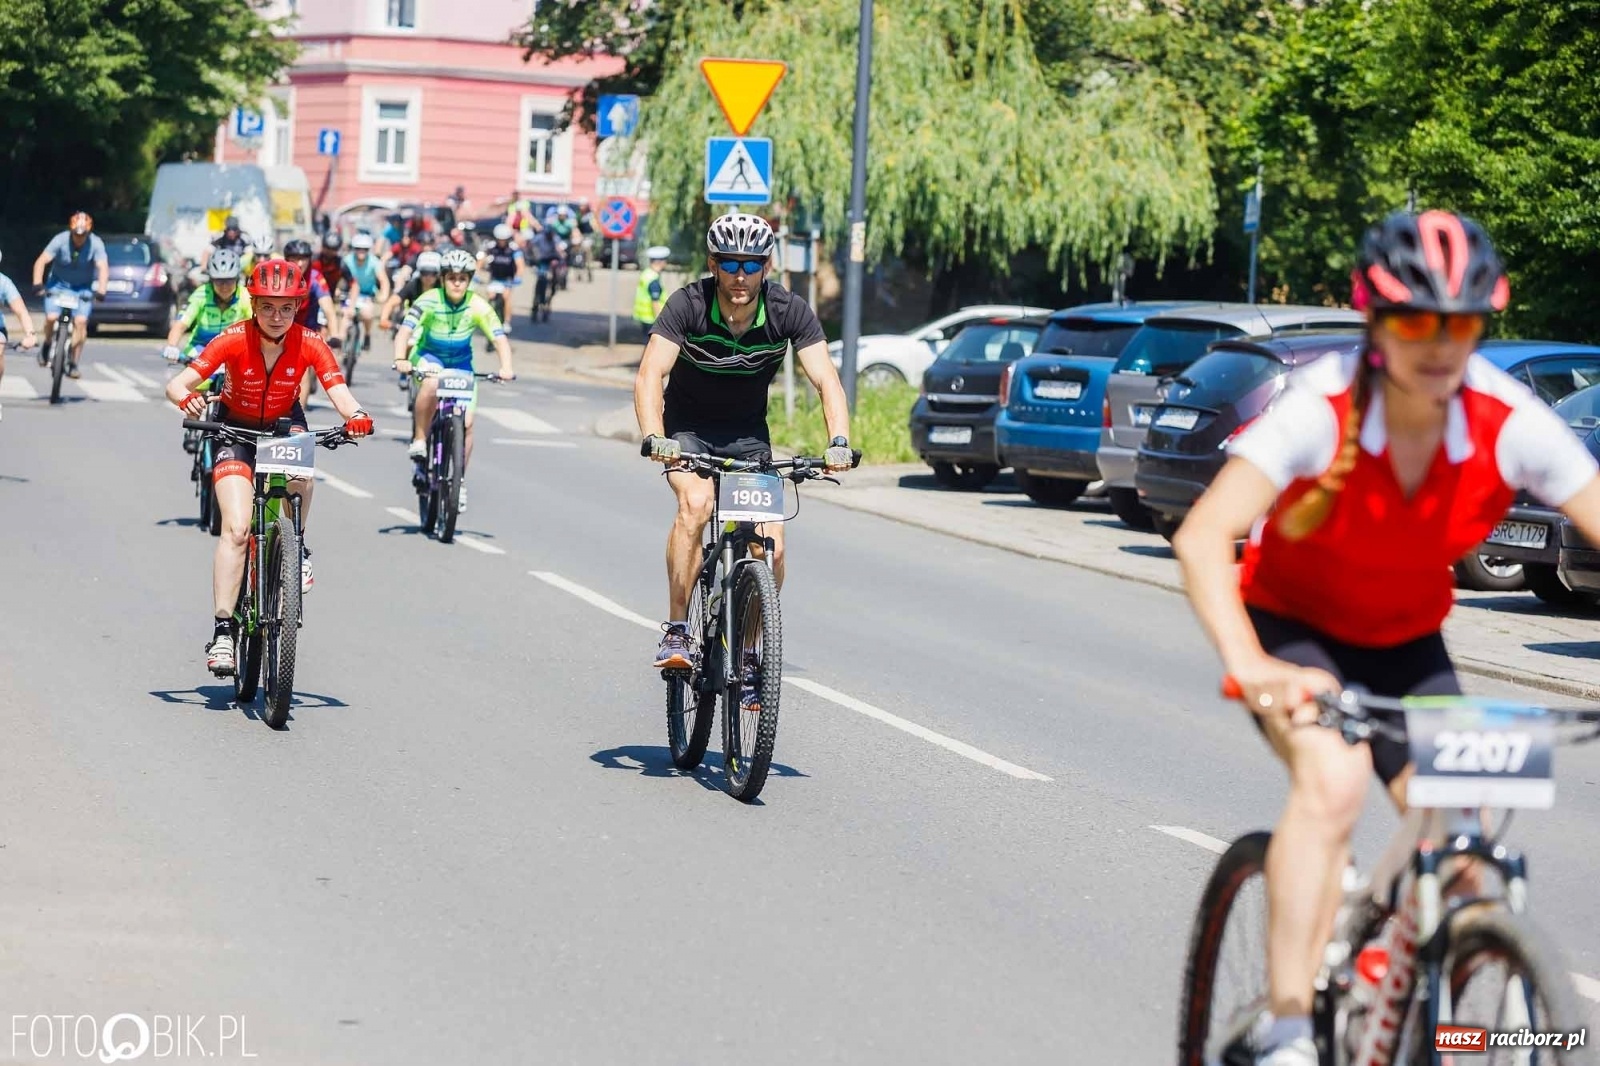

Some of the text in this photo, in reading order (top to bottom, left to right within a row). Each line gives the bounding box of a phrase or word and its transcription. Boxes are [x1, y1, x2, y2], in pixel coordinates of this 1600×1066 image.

[270, 445, 302, 461] 1251
[732, 489, 772, 507] 1903
[1494, 522, 1546, 543] SRC T179
[1433, 731, 1532, 773] 2207
